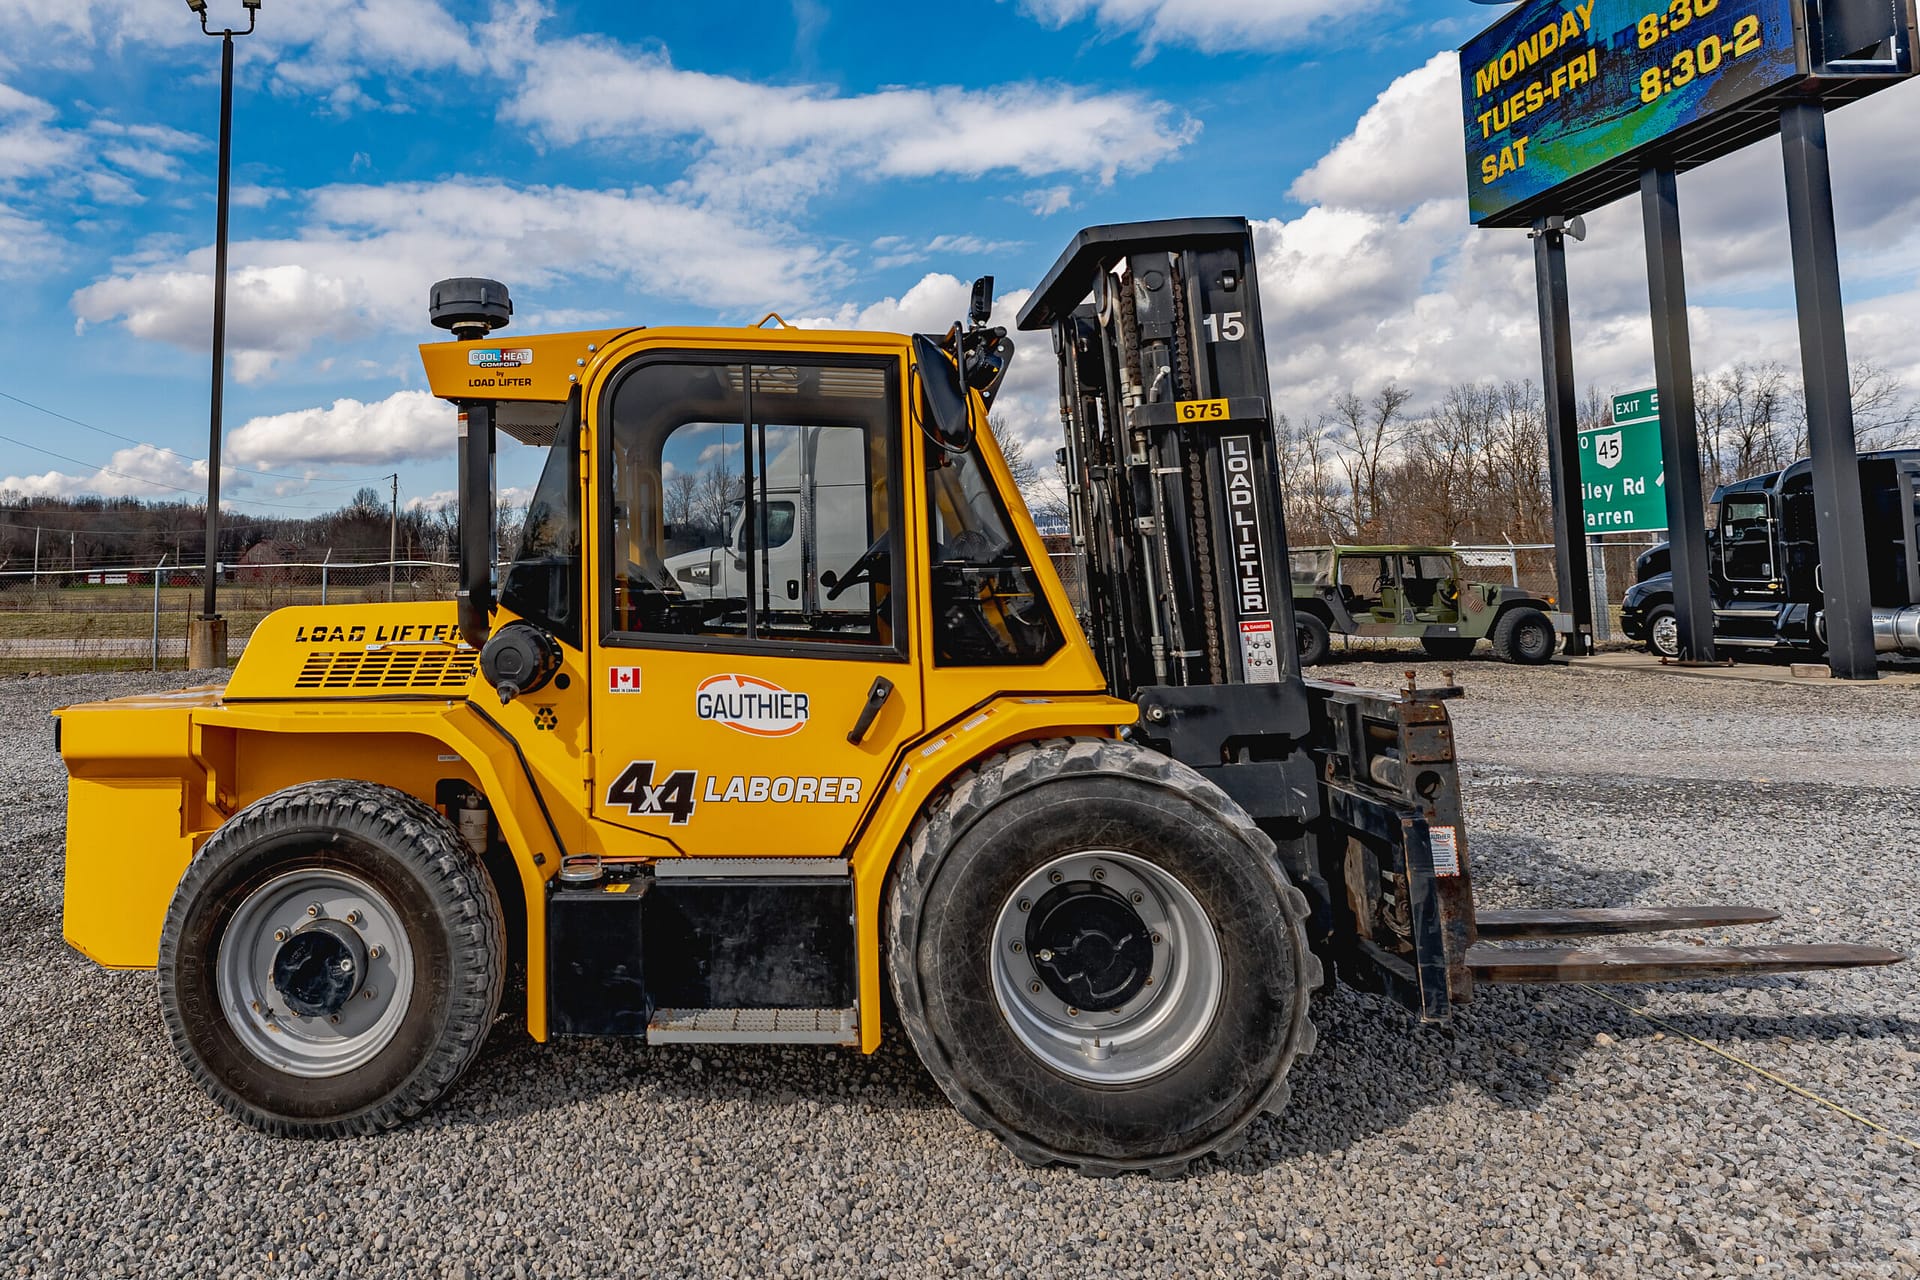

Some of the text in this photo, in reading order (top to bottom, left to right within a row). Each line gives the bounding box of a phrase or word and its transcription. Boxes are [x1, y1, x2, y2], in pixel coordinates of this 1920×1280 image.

[1475, 0, 1595, 98] MONDAY
[1477, 48, 1598, 139] TUES-FRI
[1481, 15, 1761, 184] SAT 8:30-2
[1203, 312, 1245, 342] 15
[468, 378, 531, 387] LOAD LIFTER
[496, 370, 504, 378] by
[1183, 403, 1223, 419] 675
[1616, 400, 1640, 415] EXIT
[1579, 437, 1620, 460] O 45
[1581, 476, 1645, 503] iley Rd
[1227, 441, 1263, 610] LOAD LIFTER
[1583, 509, 1634, 526] arren
[295, 626, 366, 643] LOAD
[697, 693, 809, 719] GAUTHIER
[703, 776, 863, 803] LABORER
